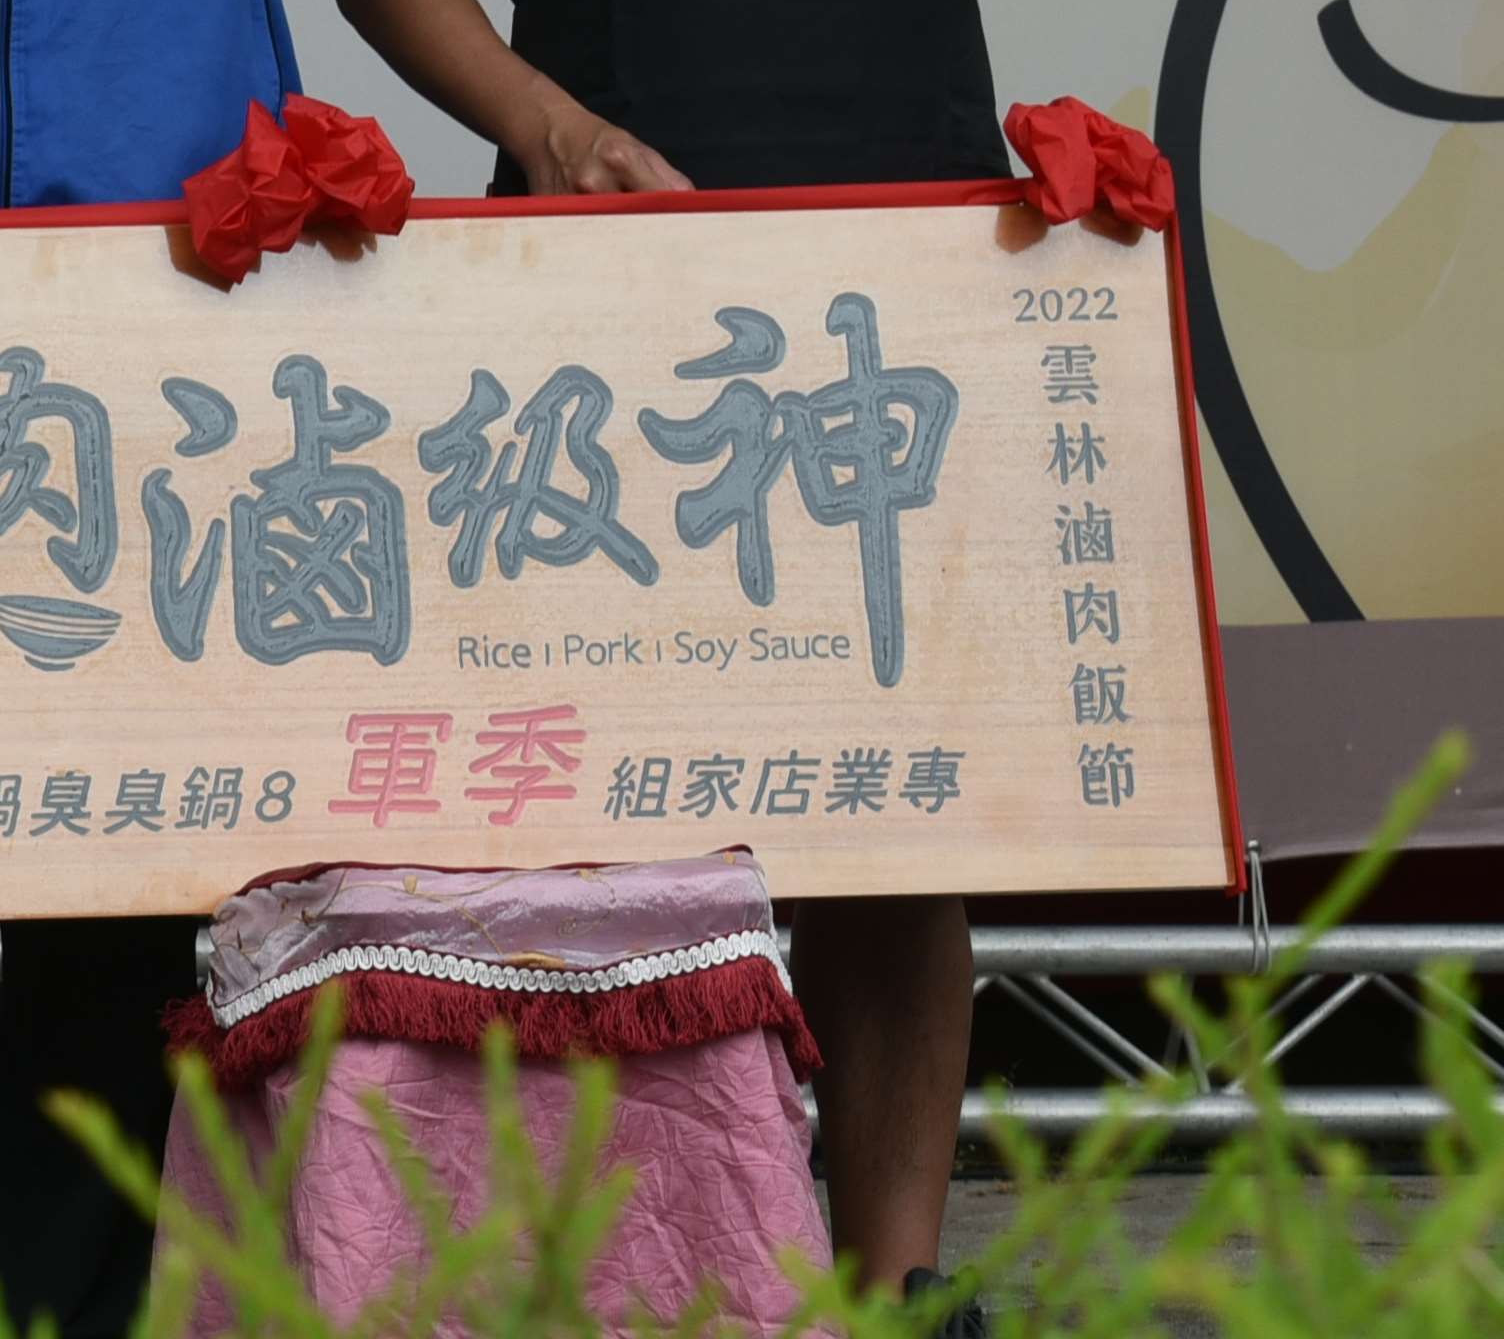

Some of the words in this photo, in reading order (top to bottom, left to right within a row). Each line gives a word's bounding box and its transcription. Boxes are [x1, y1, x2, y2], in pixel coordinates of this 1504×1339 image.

[1011, 286, 1120, 325] 2022
[1039, 343, 1139, 811] 雲林滷肉飯節
[457, 633, 532, 671] Rice
[564, 631, 645, 668] Pork
[674, 629, 738, 673] Soy
[749, 626, 853, 662] Sauce
